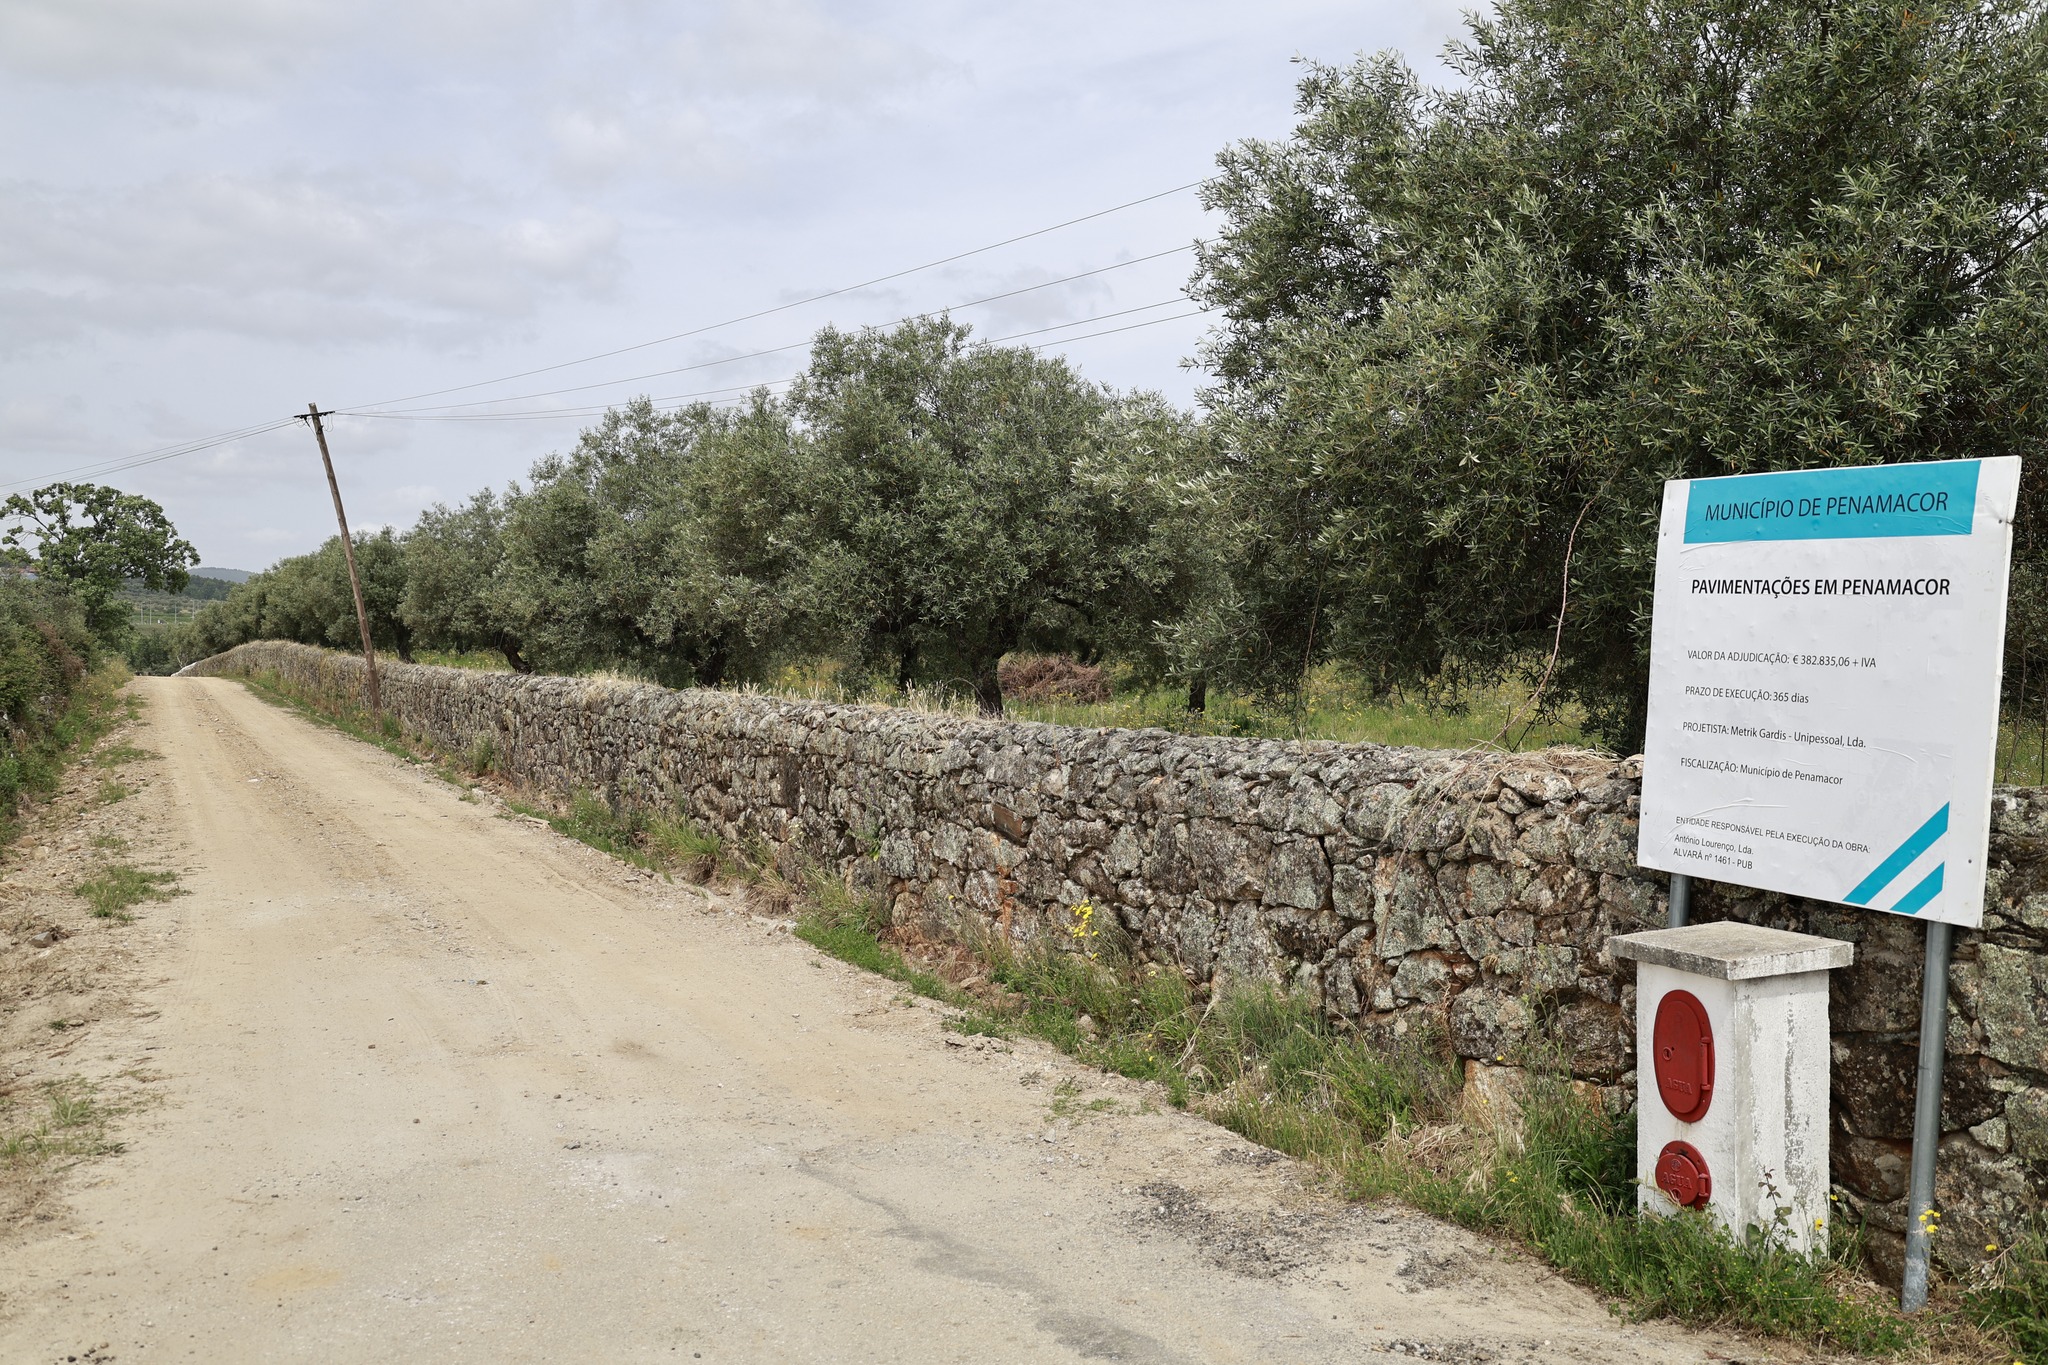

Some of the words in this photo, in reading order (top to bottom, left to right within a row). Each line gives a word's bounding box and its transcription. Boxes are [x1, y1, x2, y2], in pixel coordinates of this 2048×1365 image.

[1705, 498, 1793, 521] MUNICÍPIO
[1799, 498, 1821, 516] DE
[1827, 492, 1948, 515] PENAMACOR
[1692, 577, 1810, 598] PAVIMENTAÇÕES
[1815, 580, 1837, 594] EM
[1842, 579, 1950, 595] PENAMACOR
[1688, 650, 1712, 659] VALOR
[1714, 651, 1725, 660] DA
[1727, 652, 1789, 665] ADJUDICAÇÃO:
[1792, 654, 1799, 664] €
[1801, 655, 1850, 667] 382.835,06
[1861, 658, 1876, 667] IVA
[1686, 686, 1711, 696] PRAZO
[1713, 688, 1723, 697] DE
[1725, 689, 1772, 701] EXECUÇÃO:
[1773, 692, 1789, 702] 365
[1791, 693, 1808, 703] dias
[1683, 722, 1729, 734] PROJETISTA:
[1731, 726, 1757, 737] Metrik
[1759, 729, 1786, 740] Gardis
[1794, 732, 1844, 747] Unipessoal,
[1847, 737, 1866, 748] Lda.
[1681, 758, 1738, 773] FISCALIZAÇÃO:
[1740, 764, 1780, 778] Município
[1782, 769, 1793, 779] de
[1795, 770, 1843, 784] Penamacor
[1674, 834, 1700, 846] António
[1702, 838, 1736, 852] Lourenço,
[1738, 844, 1753, 855] Lda.
[1676, 817, 1709, 827] ENTIDADE
[1711, 821, 1763, 836] RESPONSÁVEL
[1766, 830, 1784, 839] PELA
[1787, 833, 1830, 847] EXECUÇÃO
[1832, 840, 1843, 849] DA
[1845, 842, 1871, 854] OBRA:
[1674, 846, 1703, 860] ALVARÁ
[1715, 854, 1731, 865] 1461
[1737, 859, 1752, 869] PUB
[1661, 1171, 1692, 1190] AGUA
